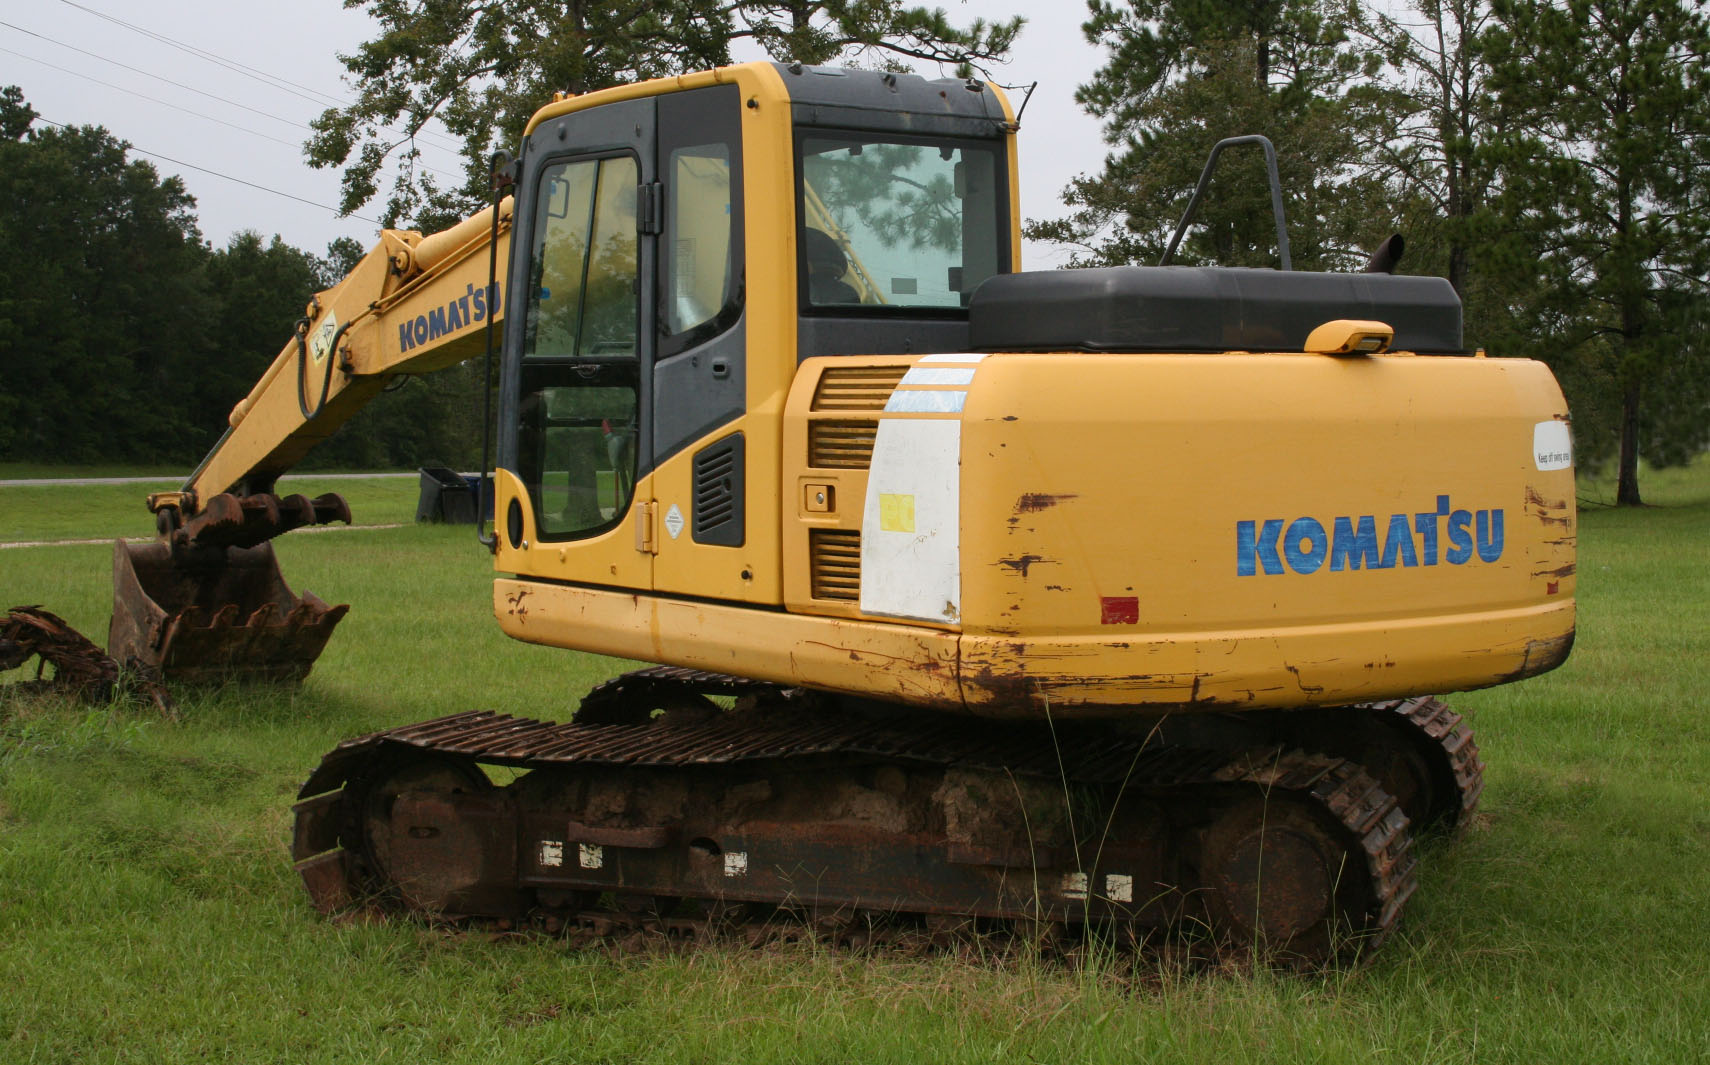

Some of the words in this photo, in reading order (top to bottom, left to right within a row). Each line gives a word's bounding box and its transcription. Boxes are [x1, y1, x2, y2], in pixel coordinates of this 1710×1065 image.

[399, 281, 501, 353] KOMATSU
[1538, 453, 1548, 463] Keep
[1237, 495, 1504, 576] KOMATSU
